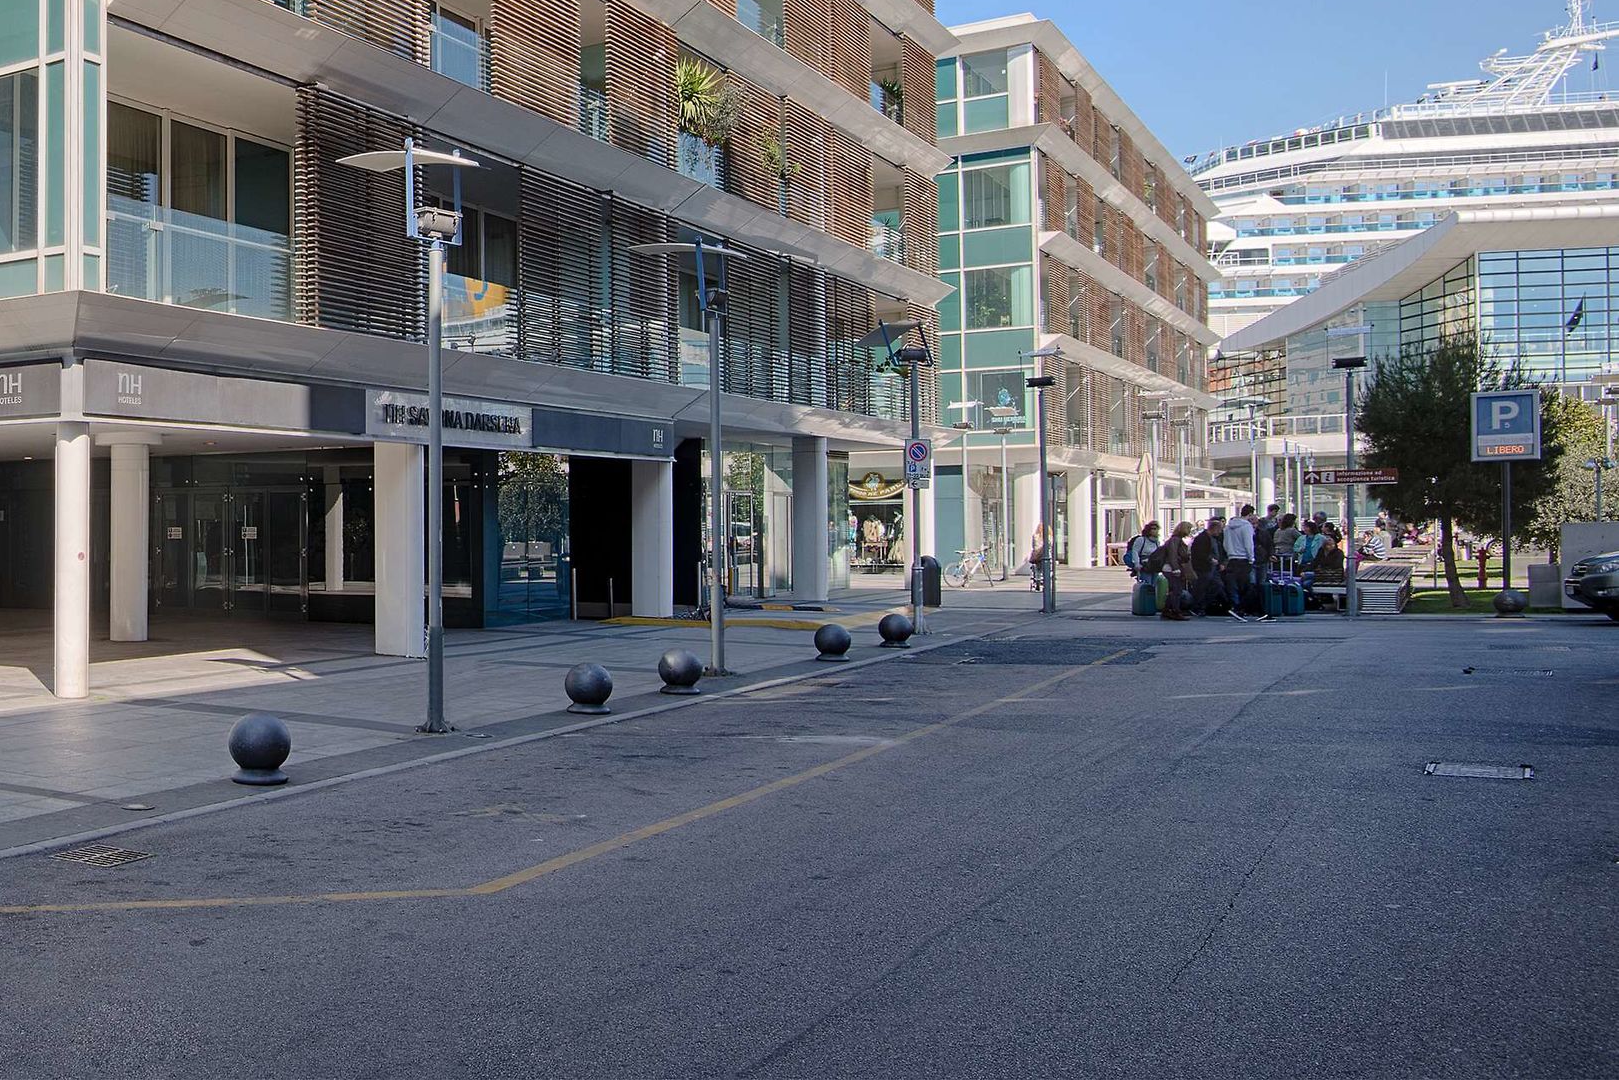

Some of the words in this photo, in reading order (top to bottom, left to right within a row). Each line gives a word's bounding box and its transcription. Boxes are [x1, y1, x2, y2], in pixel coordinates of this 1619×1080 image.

[118, 396, 142, 405] HOTELES
[1491, 401, 1520, 430] P
[1486, 445, 1525, 455] LIBERO
